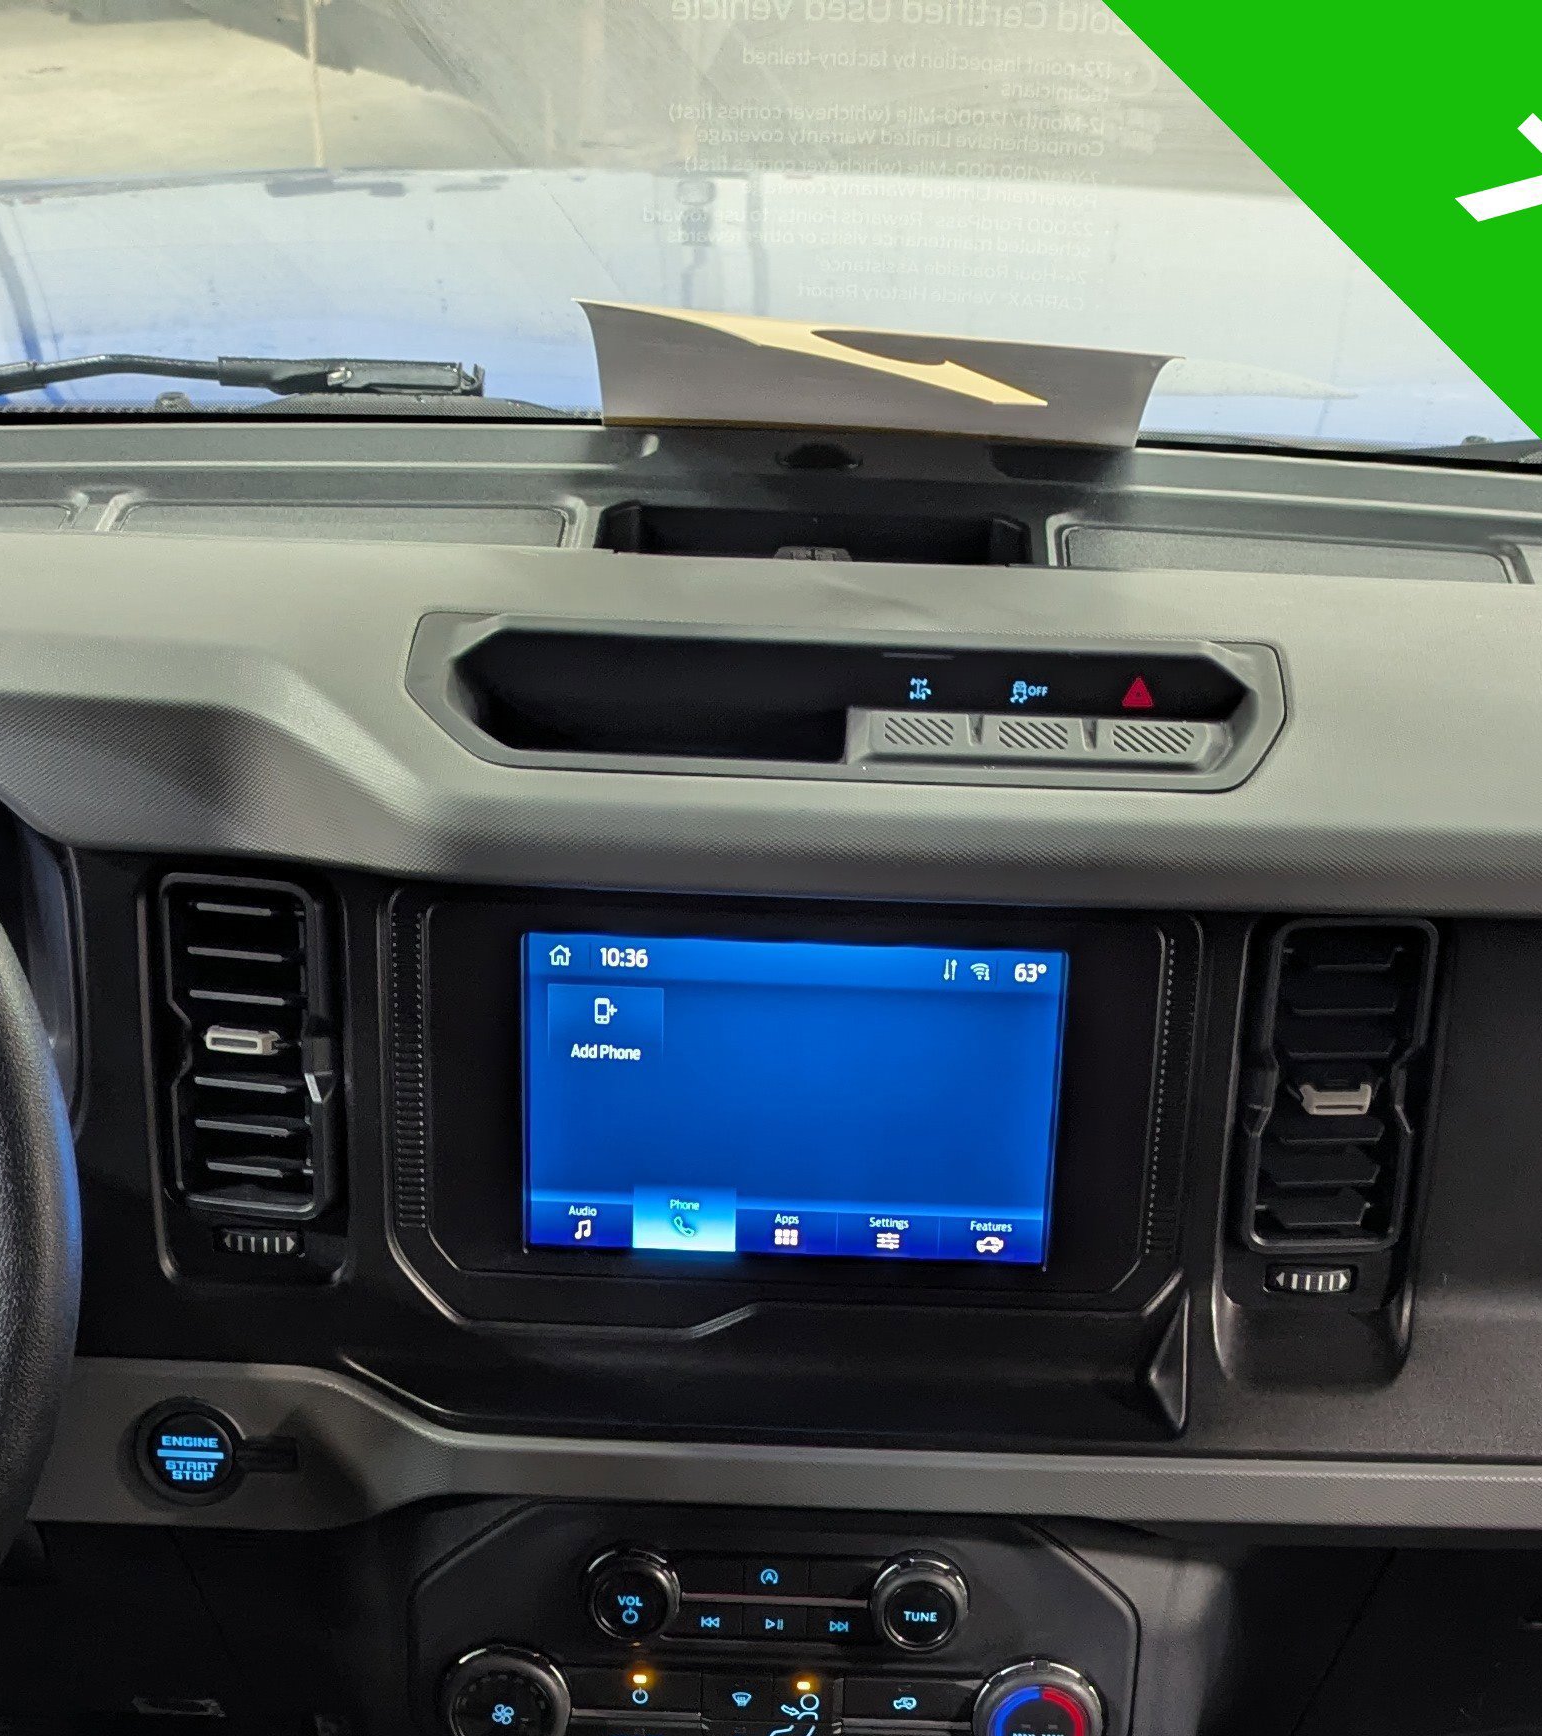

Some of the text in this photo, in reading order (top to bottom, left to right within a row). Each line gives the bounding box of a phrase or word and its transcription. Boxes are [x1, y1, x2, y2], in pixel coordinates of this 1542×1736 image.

[1027, 685, 1049, 697] OFF
[600, 947, 649, 968] 10:36
[571, 1043, 642, 1061] Add Phone
[568, 1205, 598, 1217] Audio
[669, 1198, 700, 1212] Phone
[775, 1213, 799, 1226] Apps
[869, 1216, 910, 1231] Settings
[970, 1220, 1013, 1233] Features
[161, 1435, 219, 1449] ENGINE
[165, 1459, 219, 1471] START
[172, 1470, 214, 1481] STOP
[617, 1595, 643, 1607] VOL
[904, 1610, 938, 1623] TUNE
